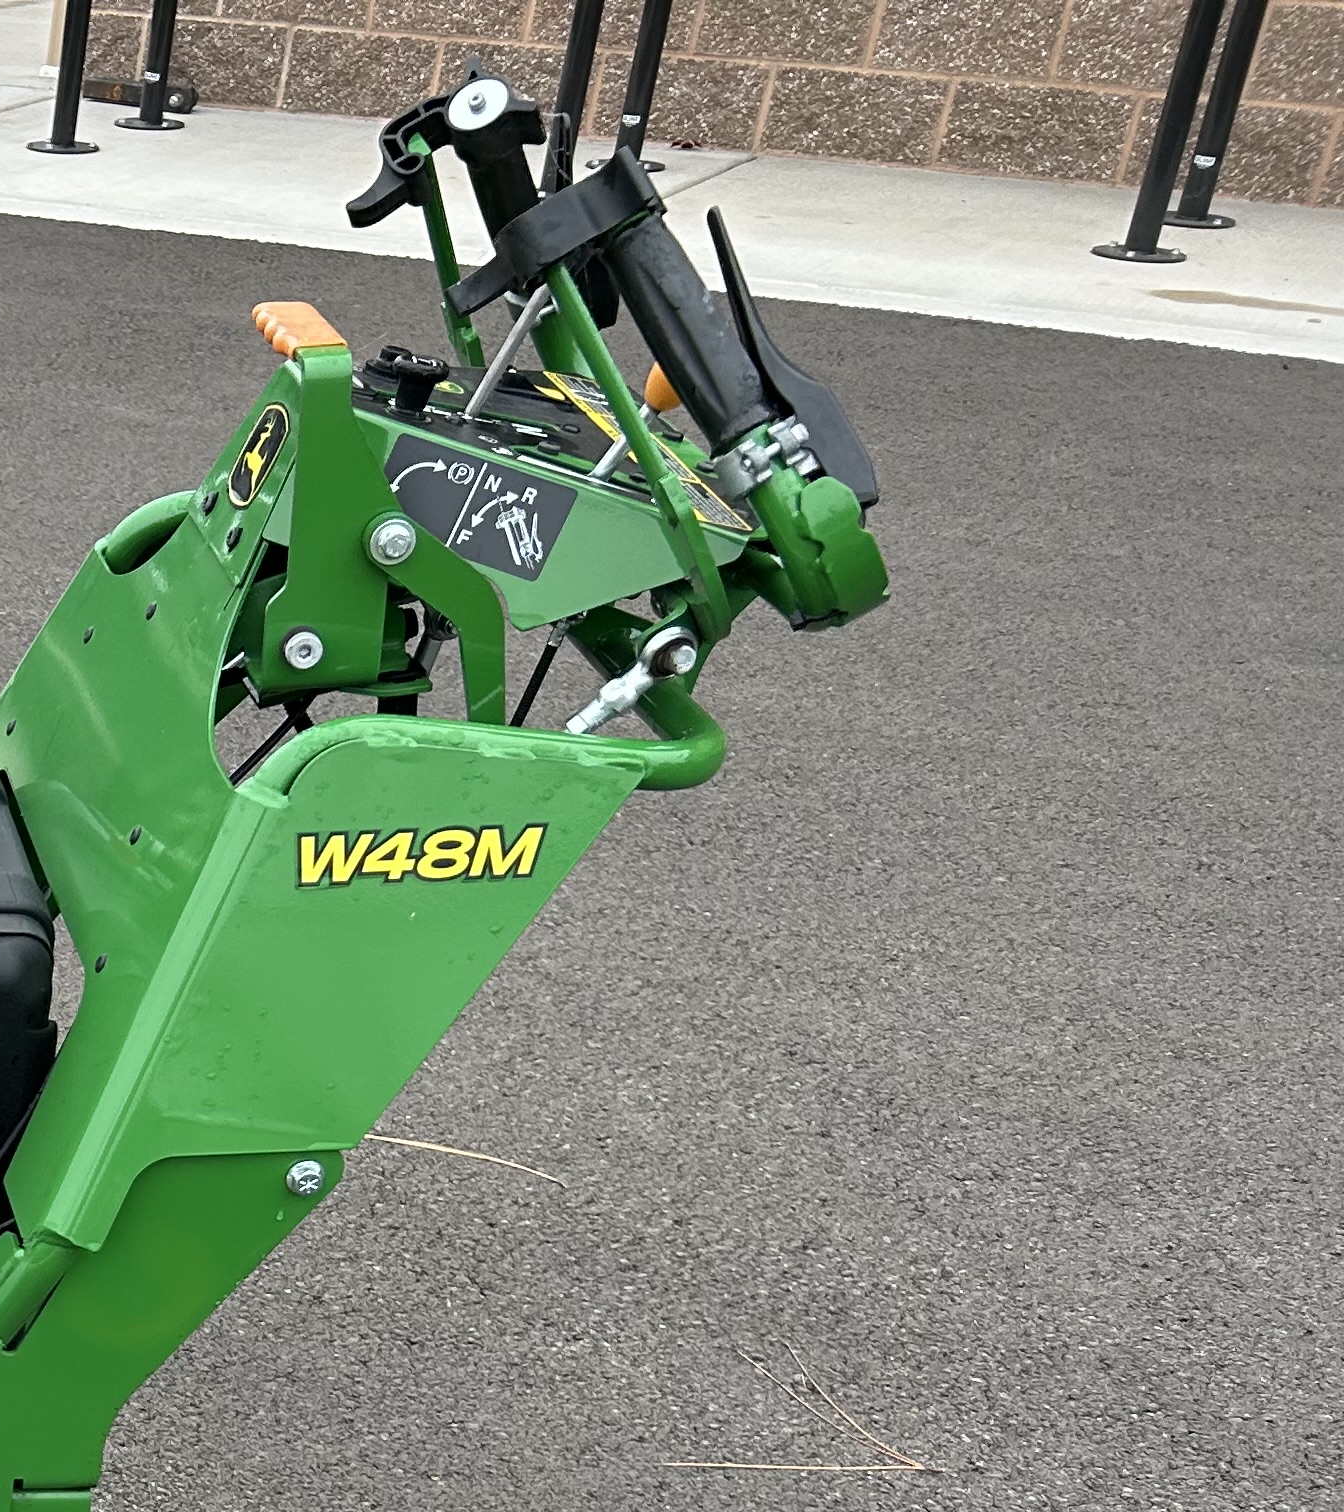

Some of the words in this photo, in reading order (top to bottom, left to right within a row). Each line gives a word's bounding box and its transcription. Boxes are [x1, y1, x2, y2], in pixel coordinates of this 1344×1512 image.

[483, 474, 503, 493] N
[520, 486, 538, 505] R
[456, 528, 474, 545] F
[294, 823, 548, 890] W48M
